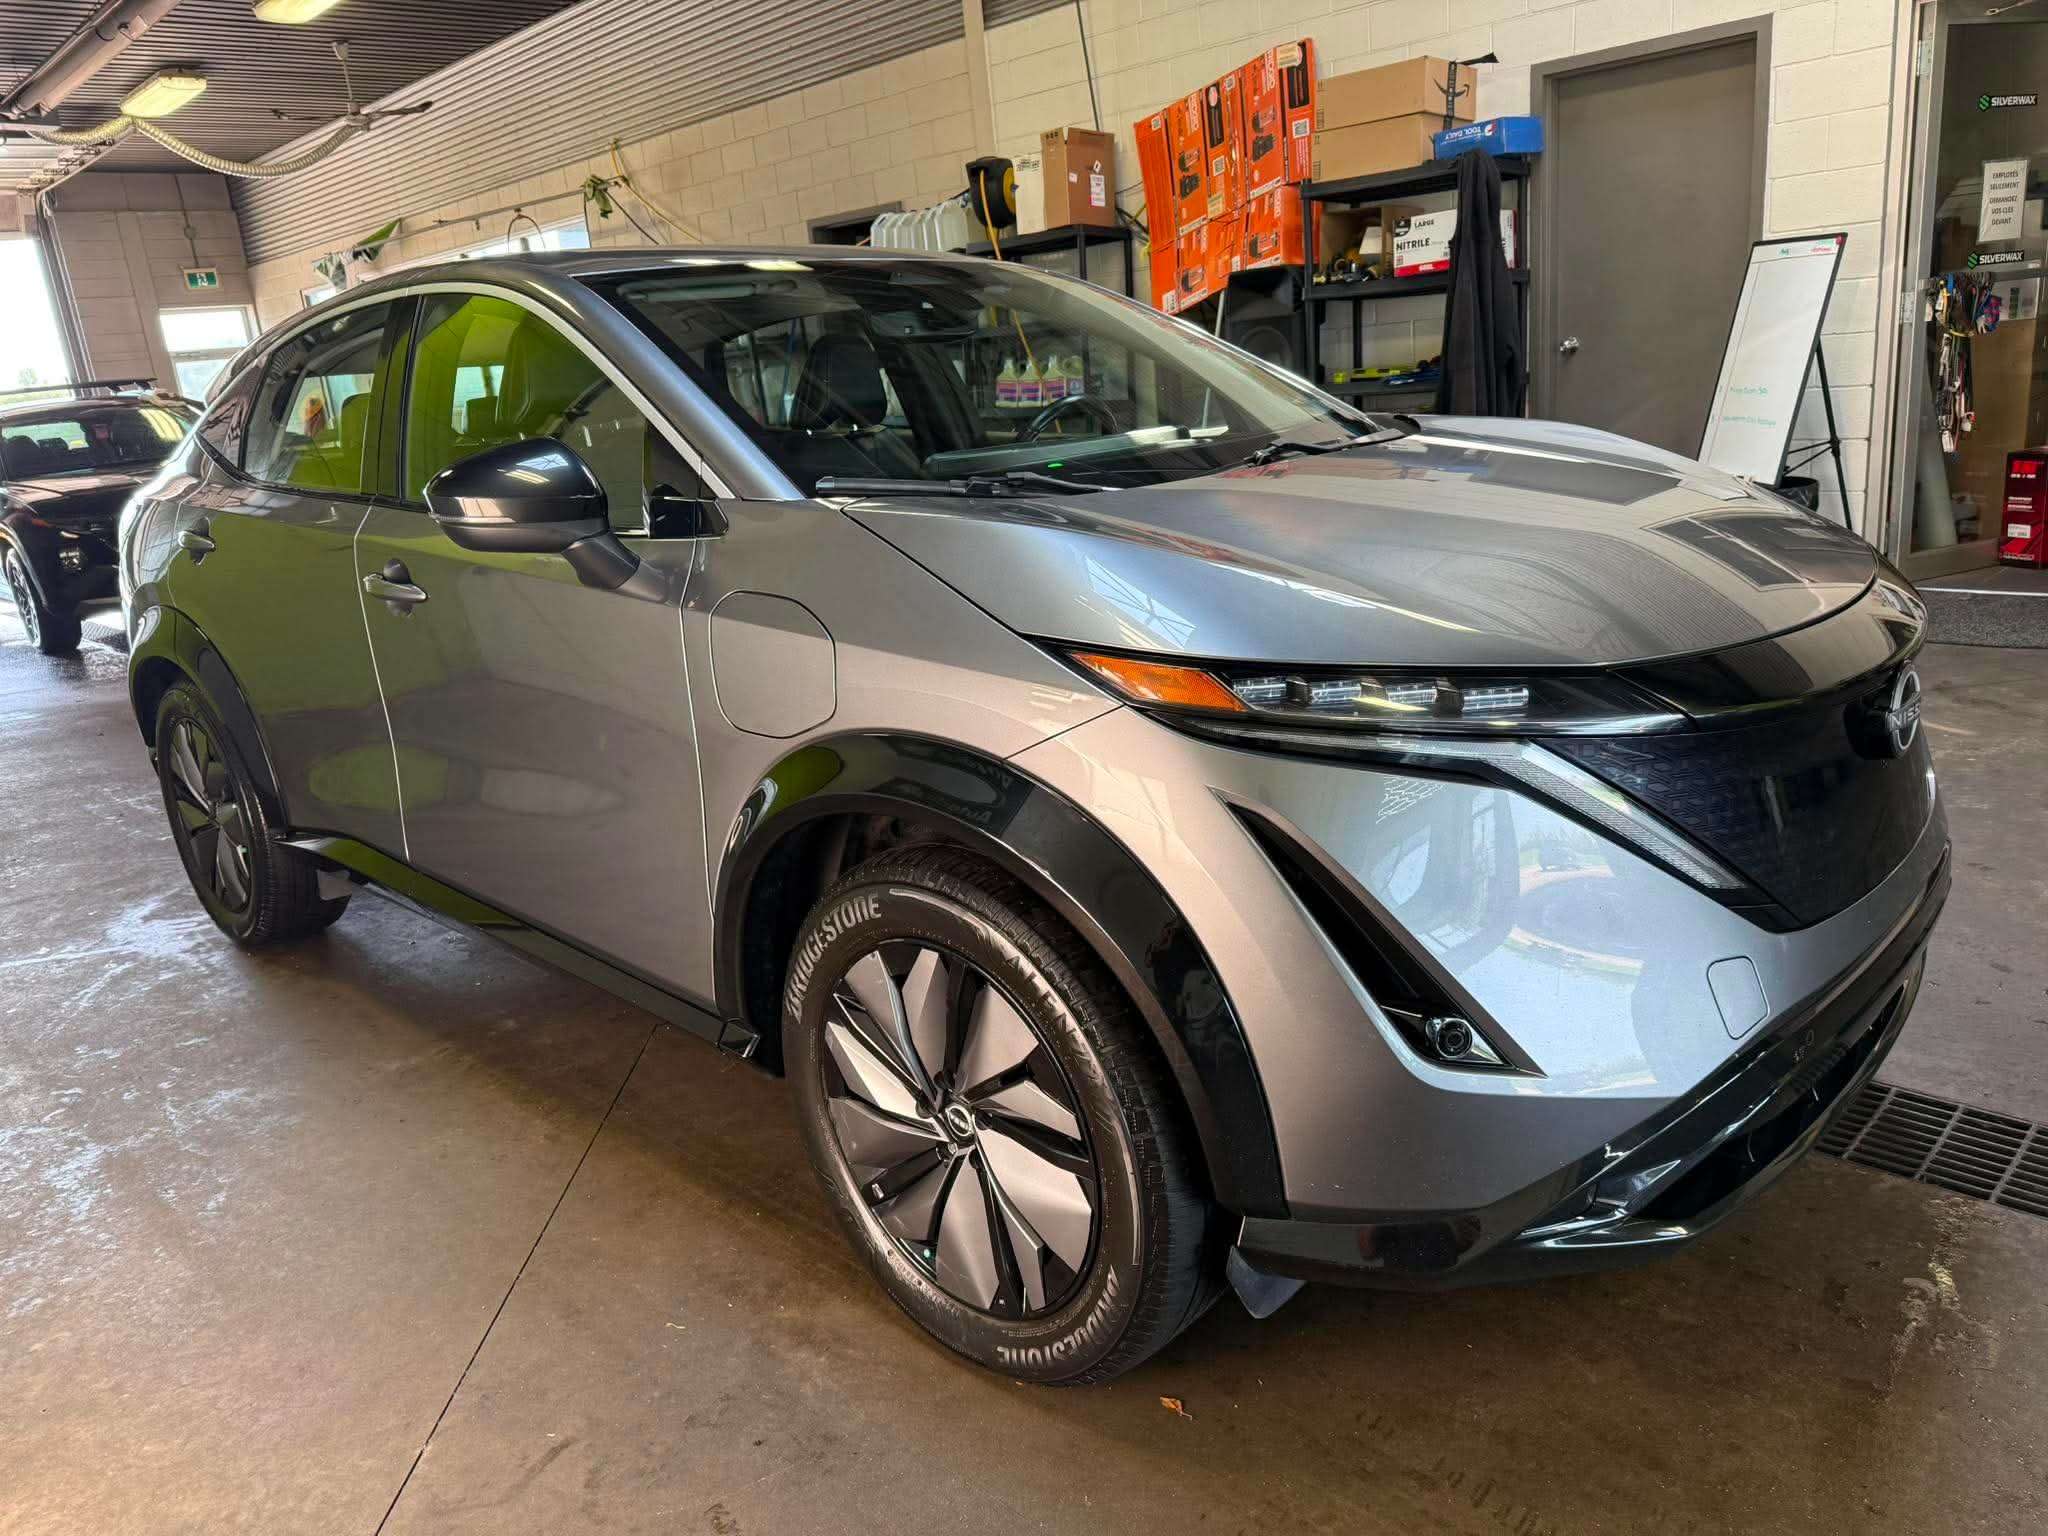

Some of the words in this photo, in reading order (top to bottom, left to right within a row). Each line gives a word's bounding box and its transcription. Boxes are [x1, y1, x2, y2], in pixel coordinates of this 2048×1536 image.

[1991, 95, 2036, 106] SILVERWAX
[1396, 238, 1430, 251] NITRILE
[1979, 251, 2023, 264] SILVERWAX
[785, 892, 881, 1024] BRIDGESTONE
